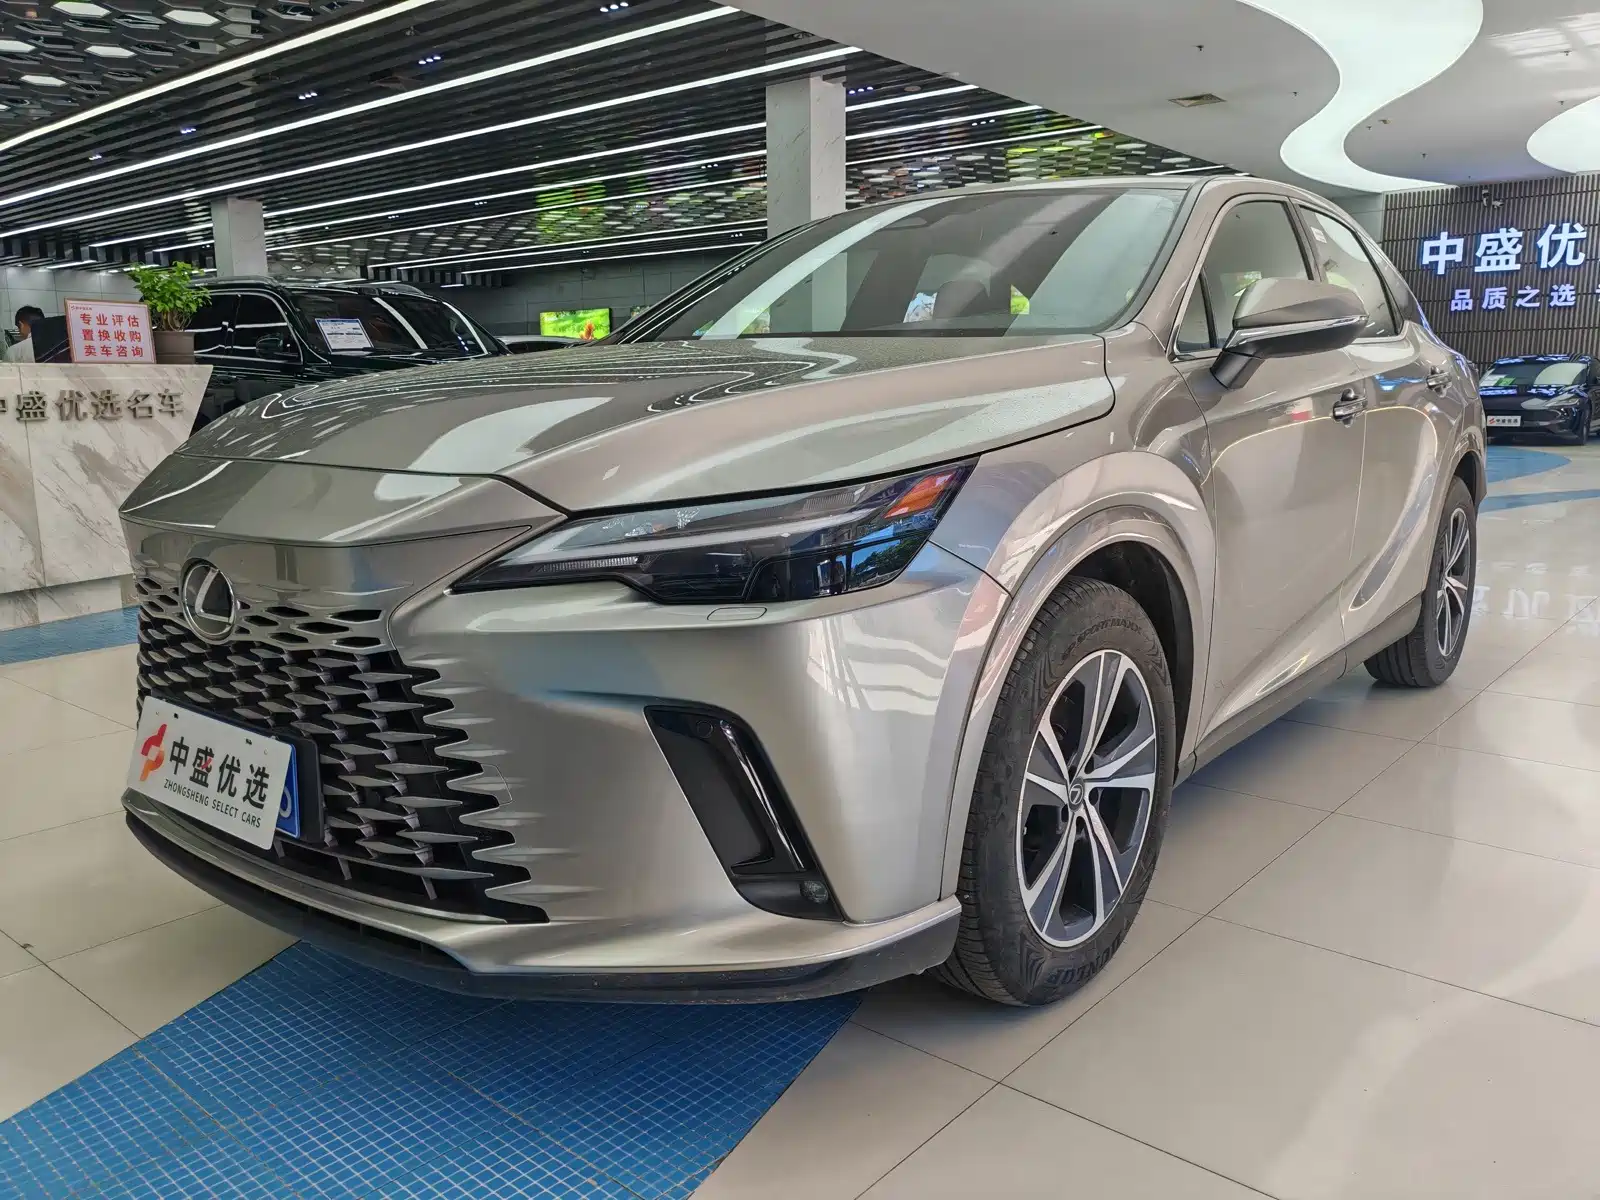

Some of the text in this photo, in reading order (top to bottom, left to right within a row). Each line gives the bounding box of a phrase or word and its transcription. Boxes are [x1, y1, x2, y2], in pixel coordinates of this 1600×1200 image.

[1421, 223, 1600, 275] 中盛优
[1450, 284, 1576, 311] 品质之选
[80, 313, 139, 327] 专业评估
[82, 329, 142, 342] 置换收购
[84, 345, 143, 357] 卖车咨询
[0, 388, 184, 421] 盛优选名车
[168, 736, 270, 809] 中盛优选
[163, 778, 262, 828] ZHONGSHENG SELECT CARS
